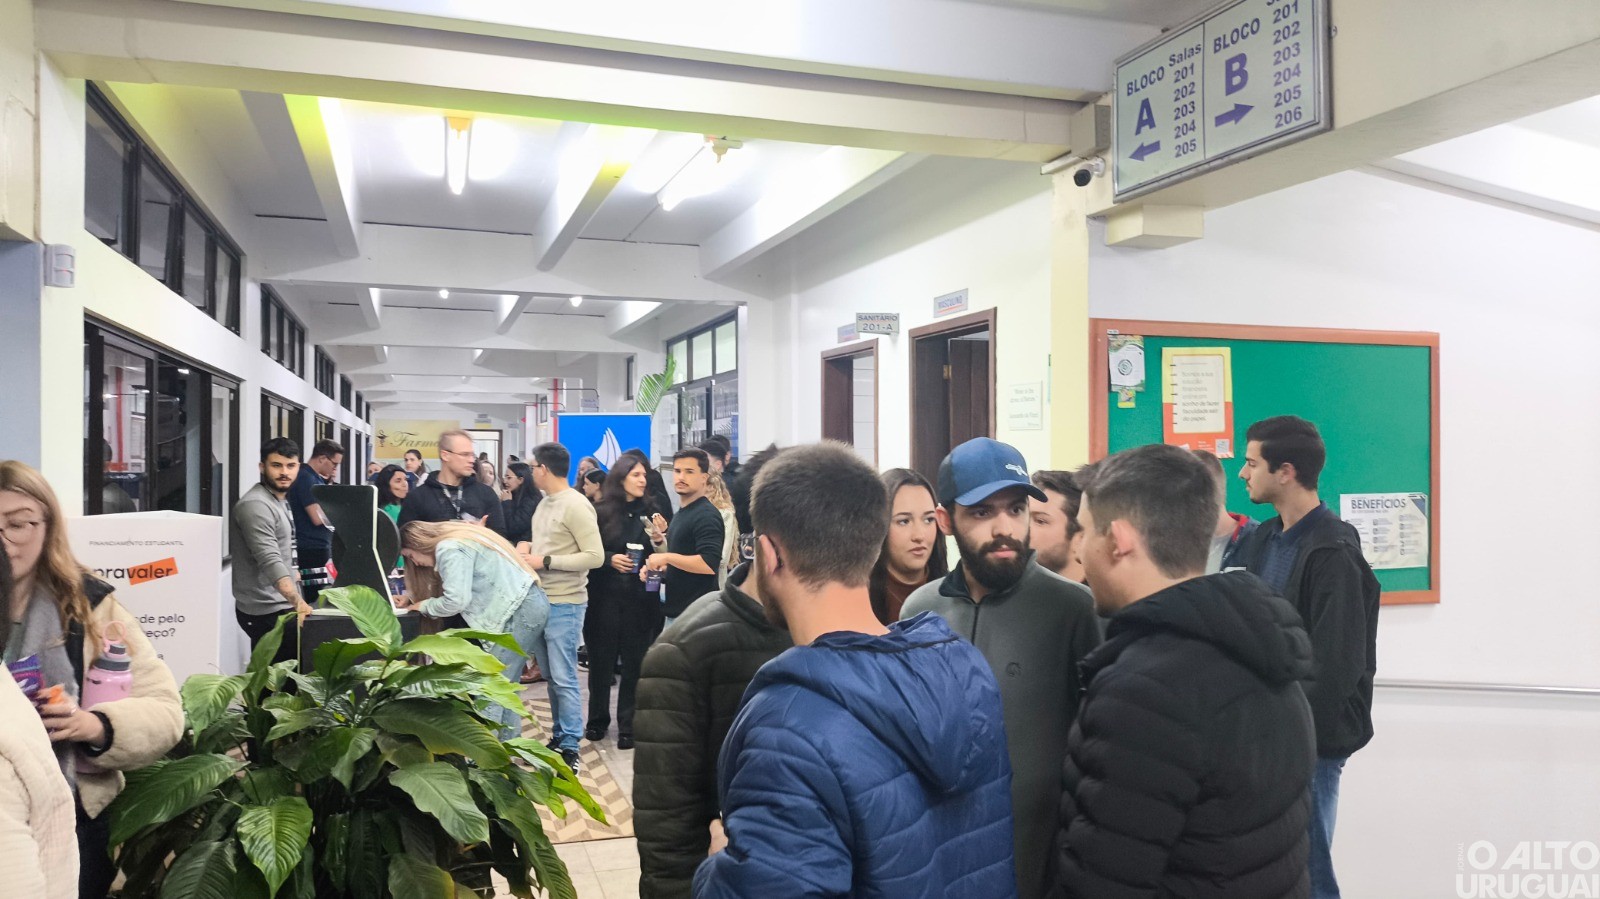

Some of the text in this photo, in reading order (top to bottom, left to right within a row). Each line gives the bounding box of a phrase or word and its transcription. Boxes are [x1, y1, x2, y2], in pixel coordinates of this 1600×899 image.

[1272, 0, 1300, 24] 201
[1213, 17, 1261, 54] BLOCO
[1273, 21, 1301, 45] 202
[1168, 43, 1202, 67] Salas
[1273, 42, 1301, 66] 203
[1126, 66, 1165, 97] BLOCO
[1173, 63, 1195, 84] 201
[1225, 53, 1249, 97] B
[1273, 62, 1302, 87] 204
[1173, 81, 1196, 102] 202
[1273, 84, 1302, 108] 205
[1134, 97, 1157, 136] A
[1173, 100, 1196, 121] 203
[1274, 106, 1303, 129] 206
[1174, 119, 1197, 140] 204
[1174, 138, 1197, 159] 205
[862, 323, 893, 331] 201-A
[158, 613, 186, 626] pelo
